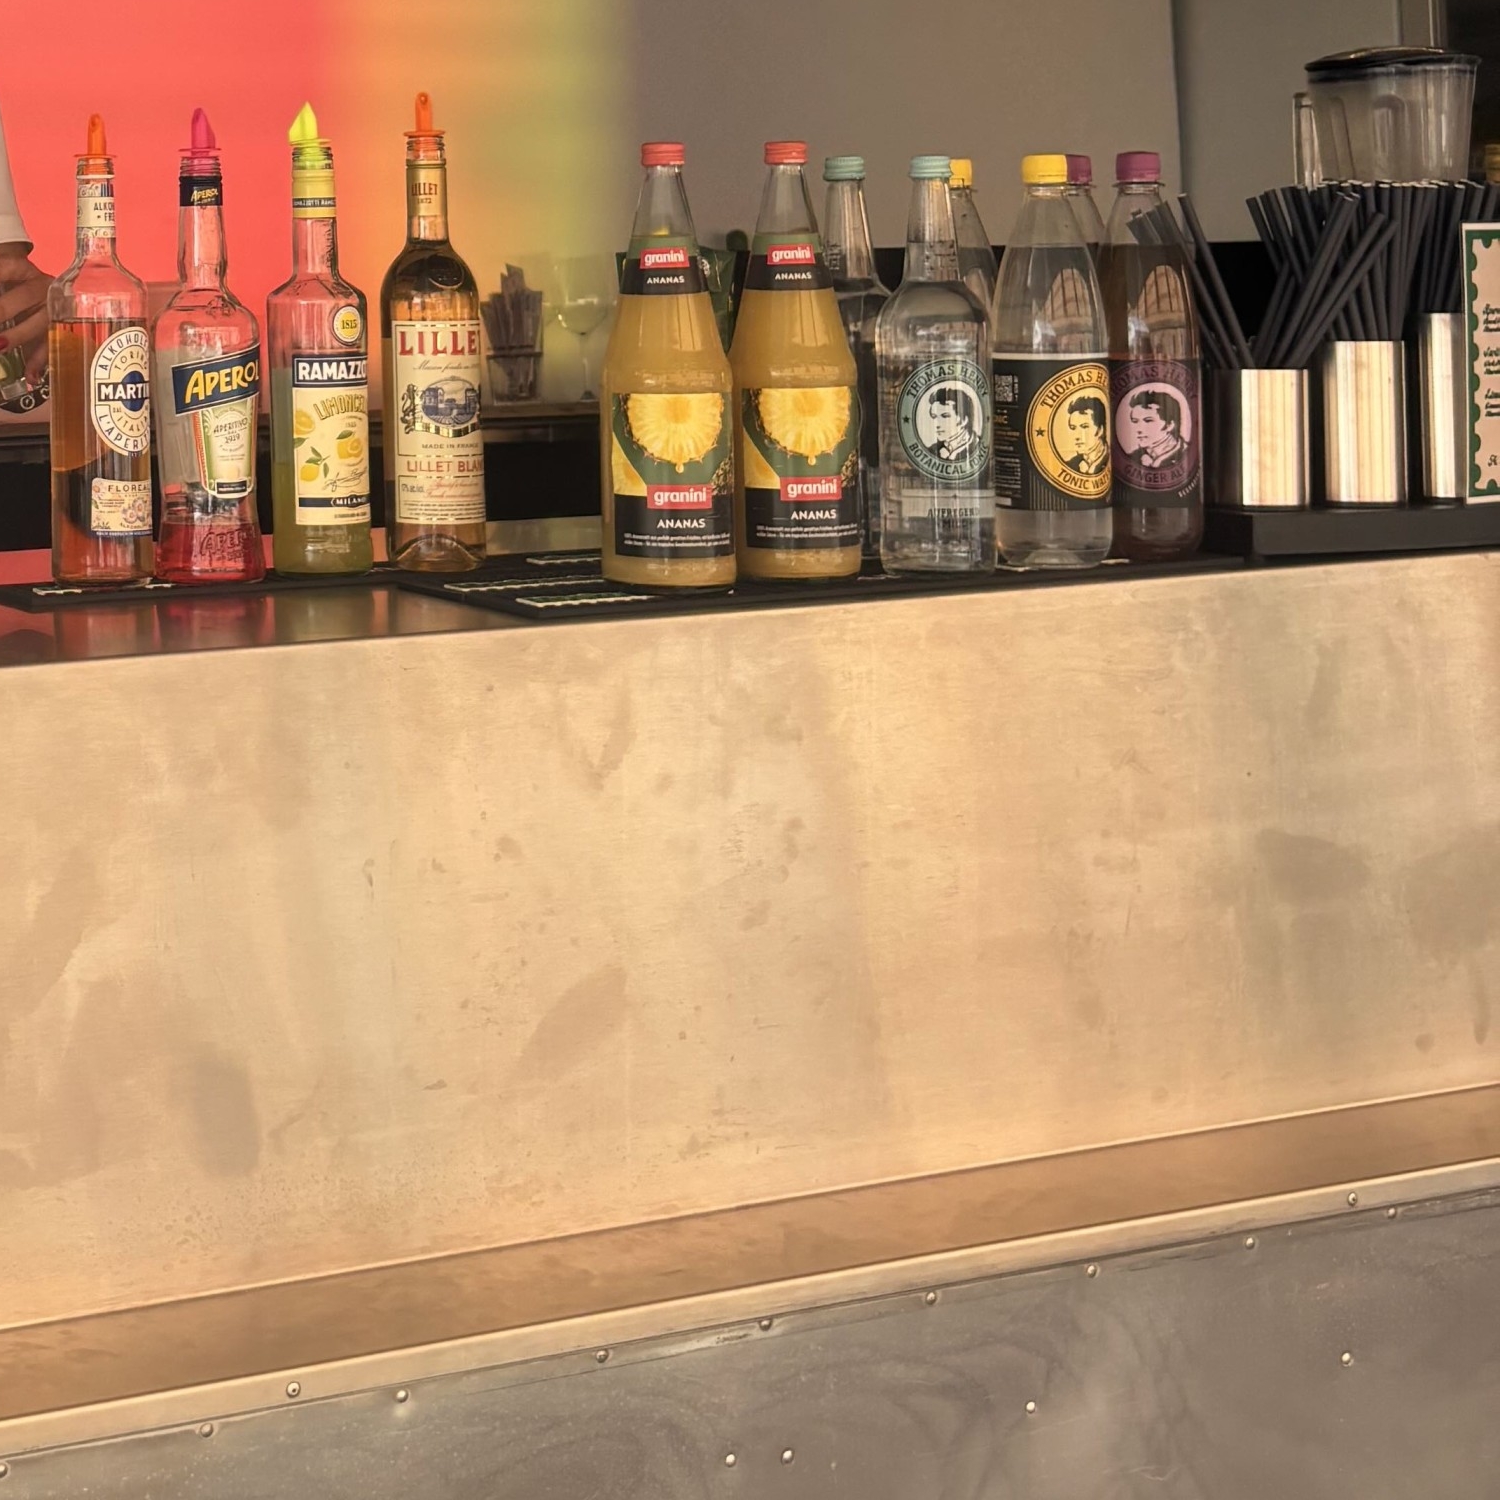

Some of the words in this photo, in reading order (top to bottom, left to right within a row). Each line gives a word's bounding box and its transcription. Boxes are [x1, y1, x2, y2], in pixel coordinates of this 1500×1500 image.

[411, 183, 438, 196] LILLET
[644, 250, 685, 266] granini
[772, 247, 811, 262] granini
[646, 275, 685, 284] ANANAS
[775, 271, 812, 280] ANANAS
[341, 319, 358, 330] 1815
[185, 359, 260, 405] APEROL
[907, 365, 955, 398] THOMAS
[960, 365, 988, 397] HENRY
[1041, 371, 1093, 409] THOMAS
[213, 417, 248, 434] APERITIVO
[407, 460, 452, 473] LILLET
[909, 443, 966, 476] BOTANICAL
[1057, 468, 1090, 490] TONIC
[1124, 463, 1167, 484] GINGER
[787, 479, 837, 498] granini
[653, 488, 706, 506] granini
[790, 509, 837, 520] ANANAS
[657, 518, 706, 529] ANANAS
